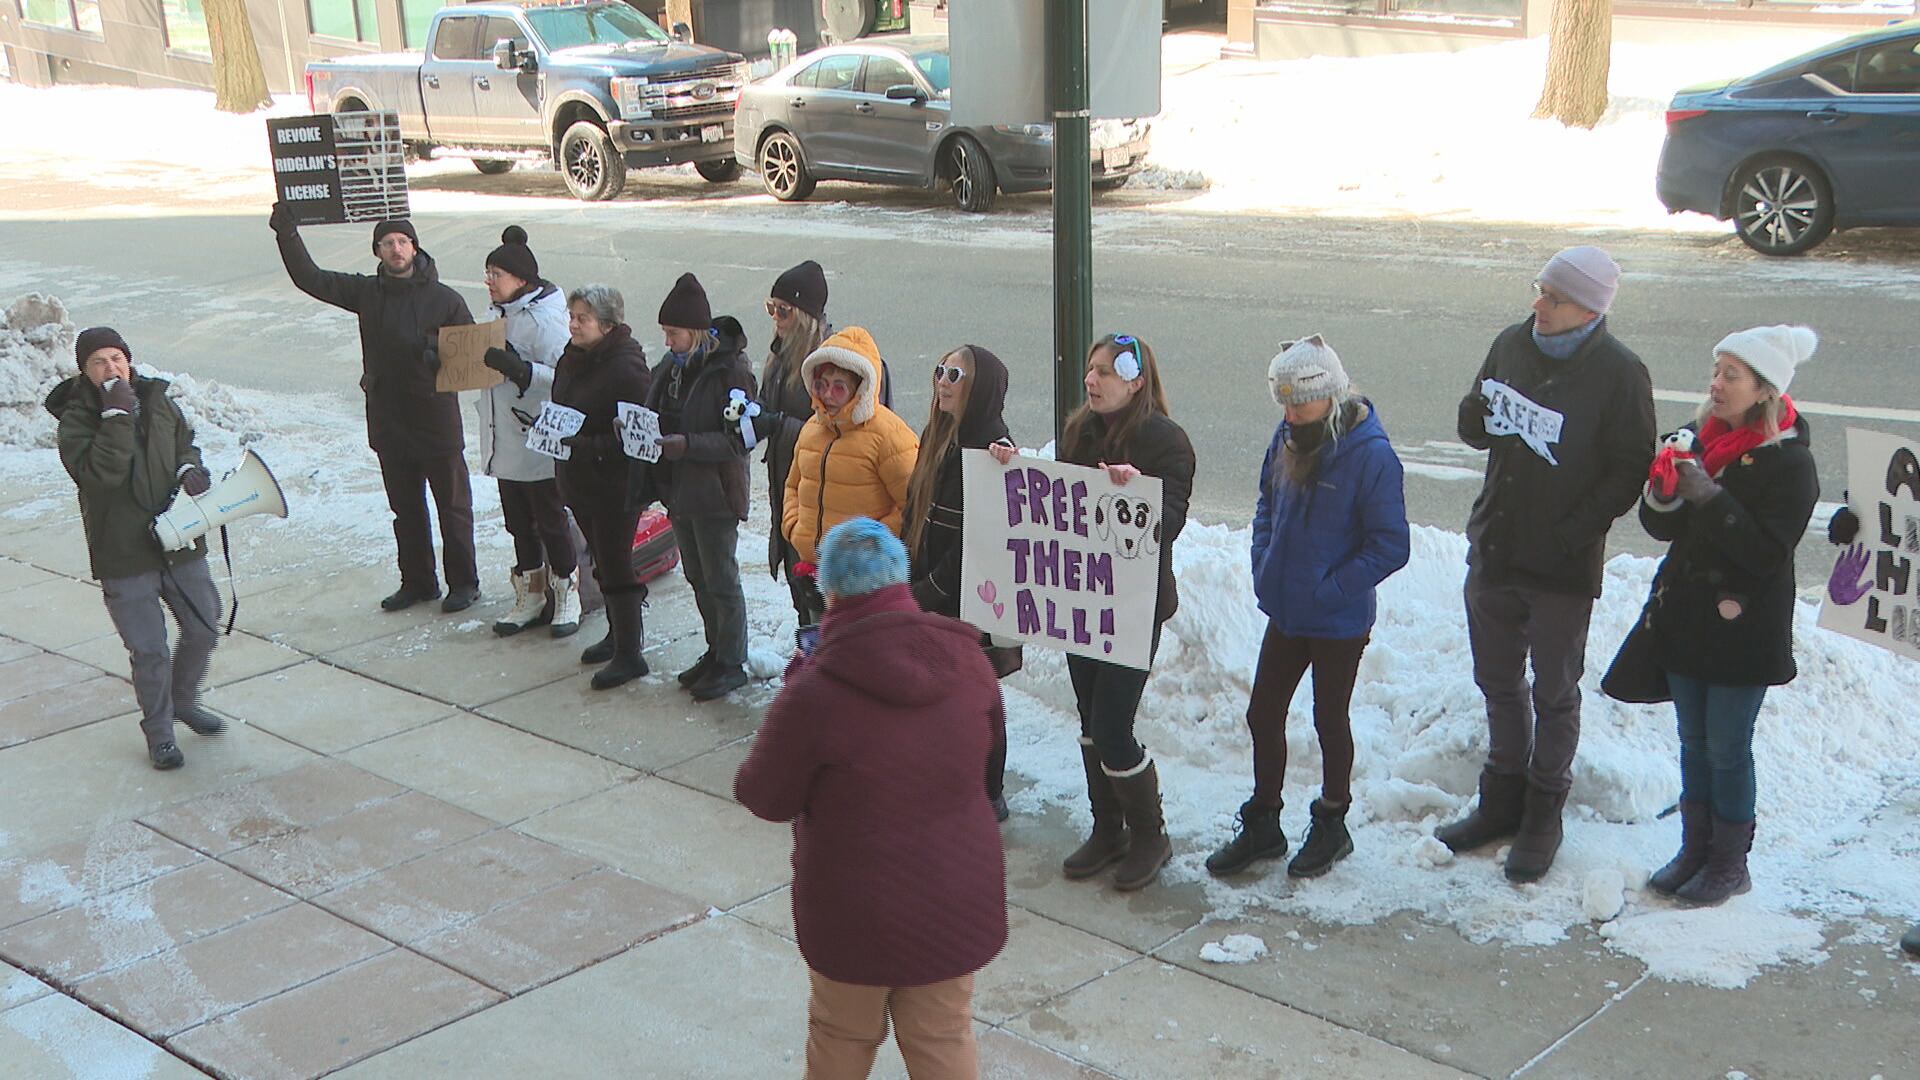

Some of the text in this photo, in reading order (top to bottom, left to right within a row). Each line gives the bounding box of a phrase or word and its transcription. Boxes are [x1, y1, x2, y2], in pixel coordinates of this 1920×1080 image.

[277, 126, 322, 144] REVOKE
[275, 155, 337, 172] RIDGLAN'S
[285, 184, 331, 200] LICENSE
[1004, 468, 1089, 538] FREE
[1006, 538, 1115, 596] THEM
[1015, 588, 1116, 654] ALL!
